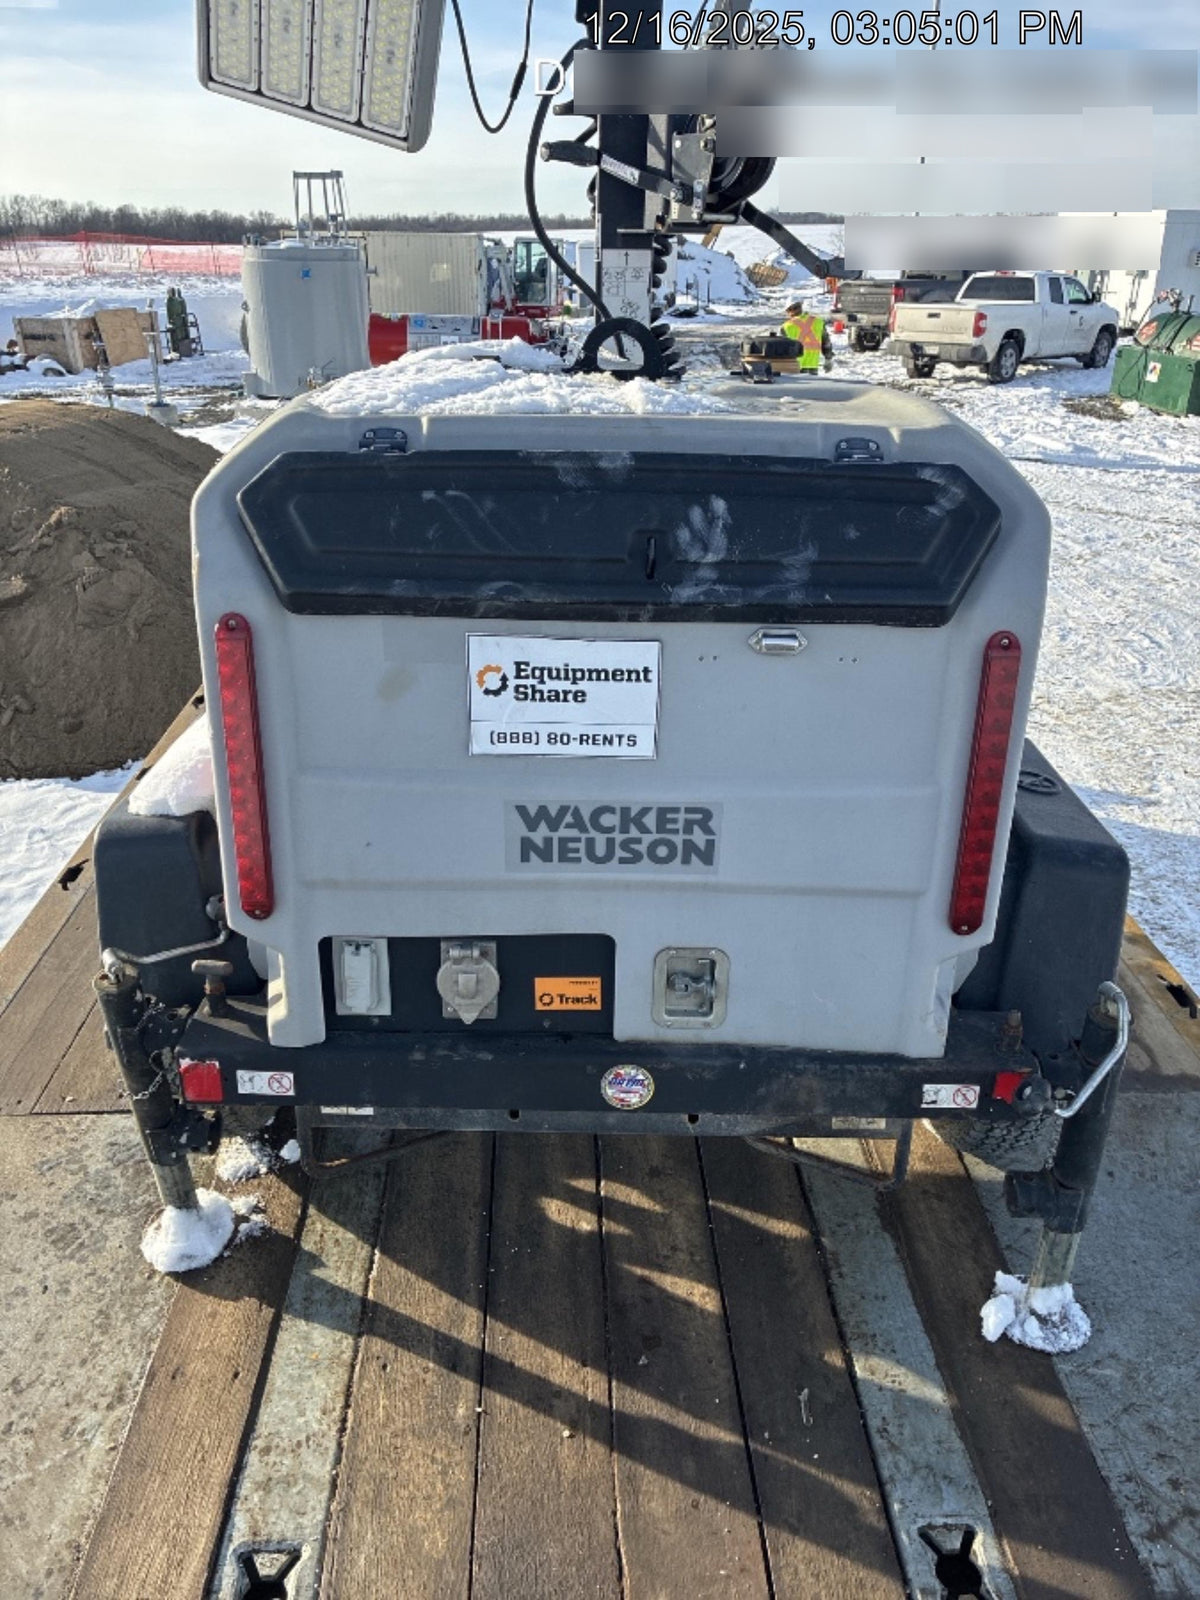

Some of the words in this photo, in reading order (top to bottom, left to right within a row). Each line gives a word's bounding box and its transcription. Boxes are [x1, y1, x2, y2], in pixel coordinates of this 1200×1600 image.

[513, 661, 652, 684] Equipment
[513, 685, 587, 704] Share
[490, 730, 539, 746] (888)
[547, 731, 638, 748] 80-RENTS
[515, 804, 716, 836] WACKER
[520, 836, 716, 866] NEUSON
[556, 993, 597, 1004] Track
